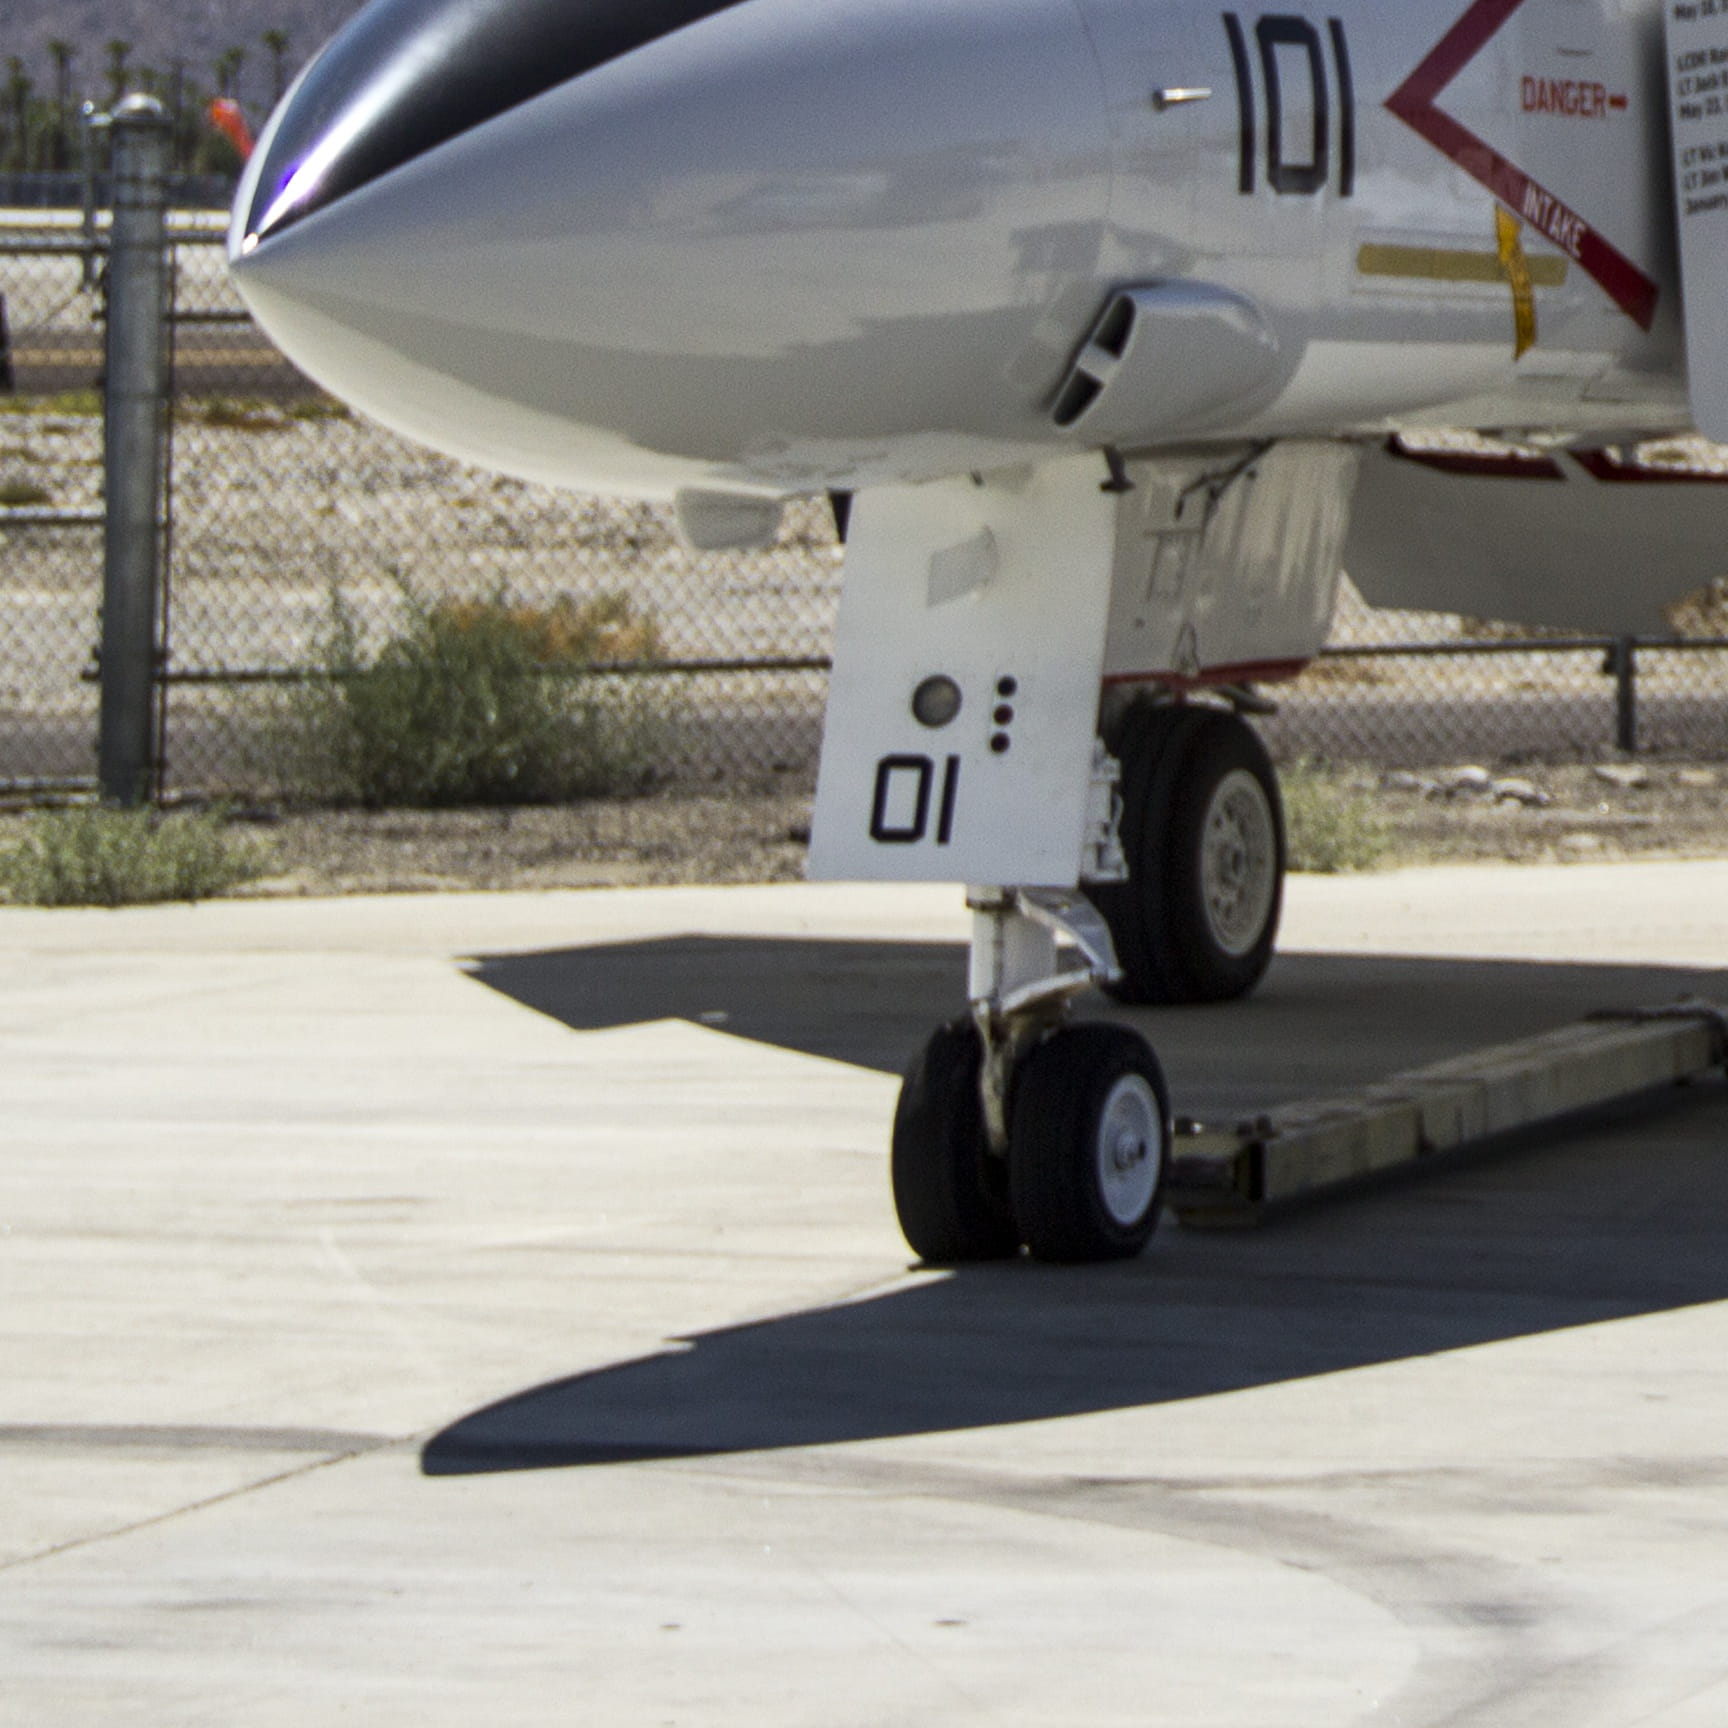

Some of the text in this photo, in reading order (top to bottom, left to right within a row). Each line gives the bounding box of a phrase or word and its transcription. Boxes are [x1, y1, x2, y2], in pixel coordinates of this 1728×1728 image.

[1221, 11, 1355, 198] 101
[1521, 75, 1607, 118] DANGER
[1523, 182, 1588, 258] INTAKE
[868, 753, 961, 846] 01
